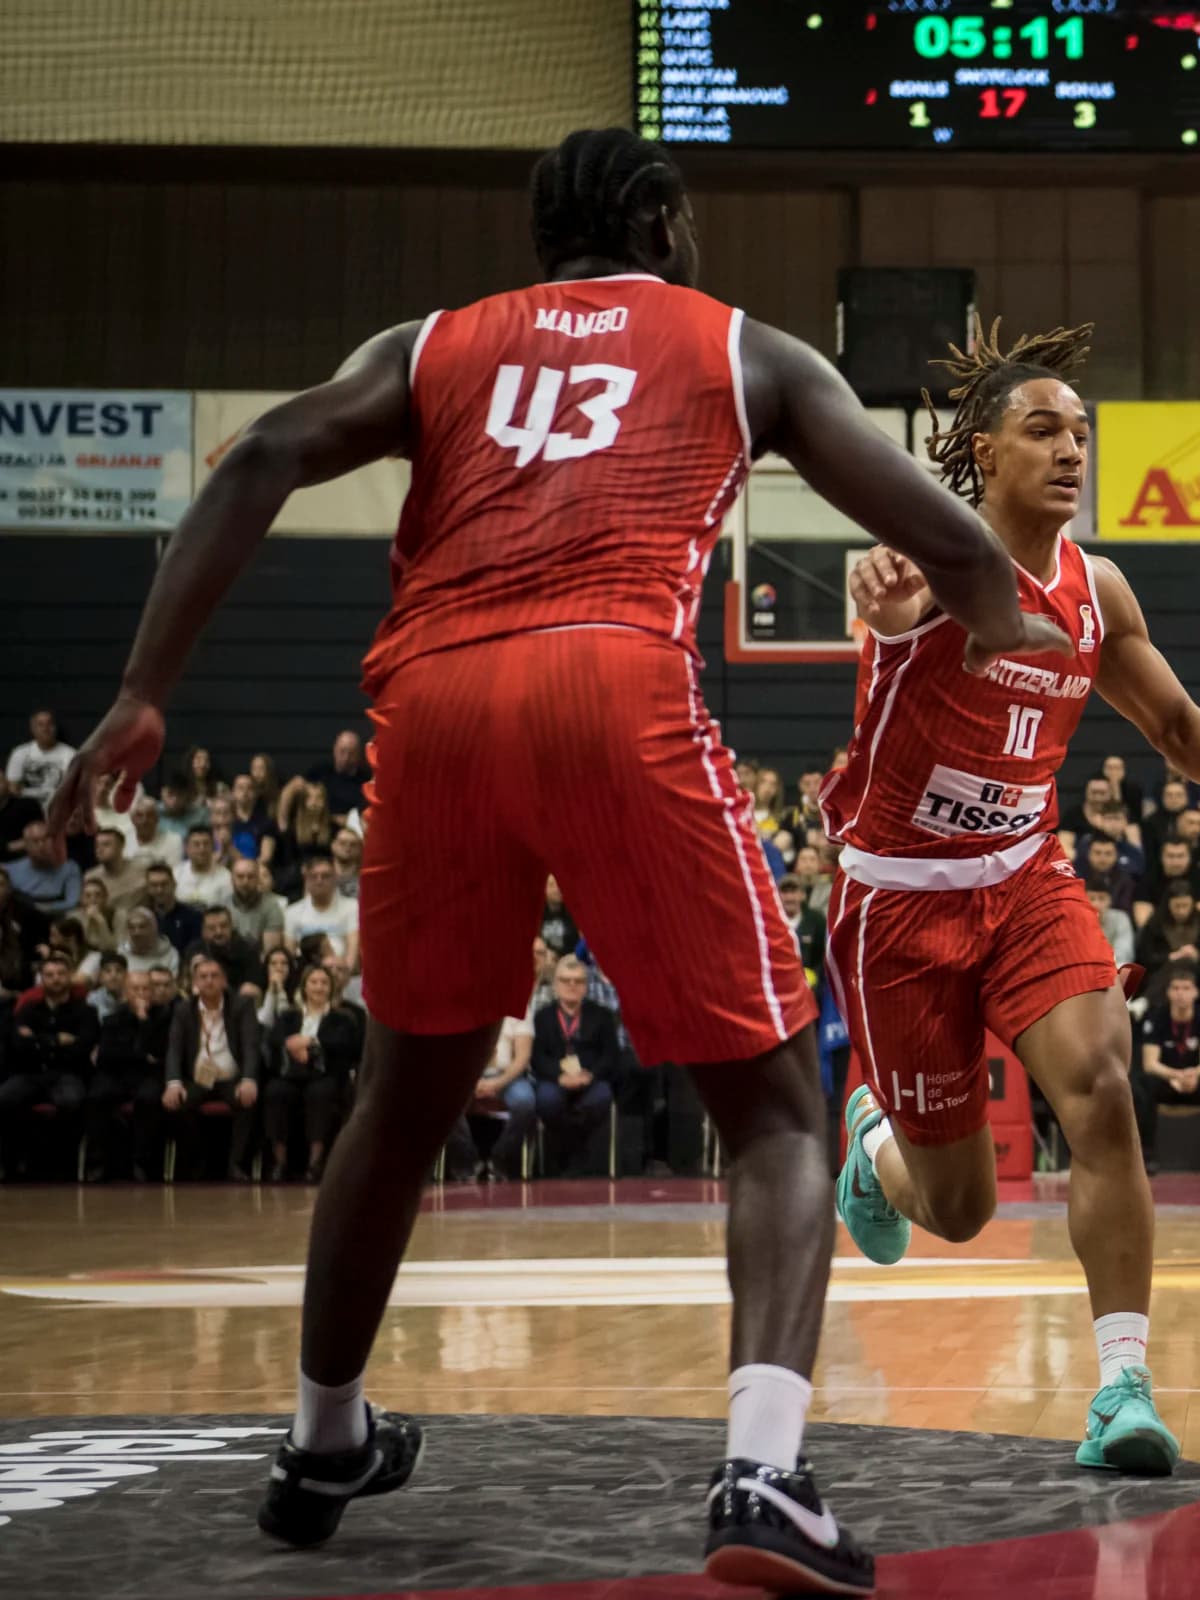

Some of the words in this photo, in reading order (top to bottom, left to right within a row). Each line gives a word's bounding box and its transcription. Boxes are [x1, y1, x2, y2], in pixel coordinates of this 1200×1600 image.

[914, 16, 1084, 59] 05:11
[908, 101, 931, 127] 1
[979, 88, 1027, 118] 17
[1072, 101, 1097, 128] 3
[534, 306, 629, 338] MAMBO
[484, 363, 638, 468] 43
[983, 657, 1092, 699] WITZERLAND
[1002, 704, 1043, 759] 10
[925, 791, 1041, 832] TISSO
[928, 1100, 944, 1112] La
[943, 1092, 969, 1109] Tour
